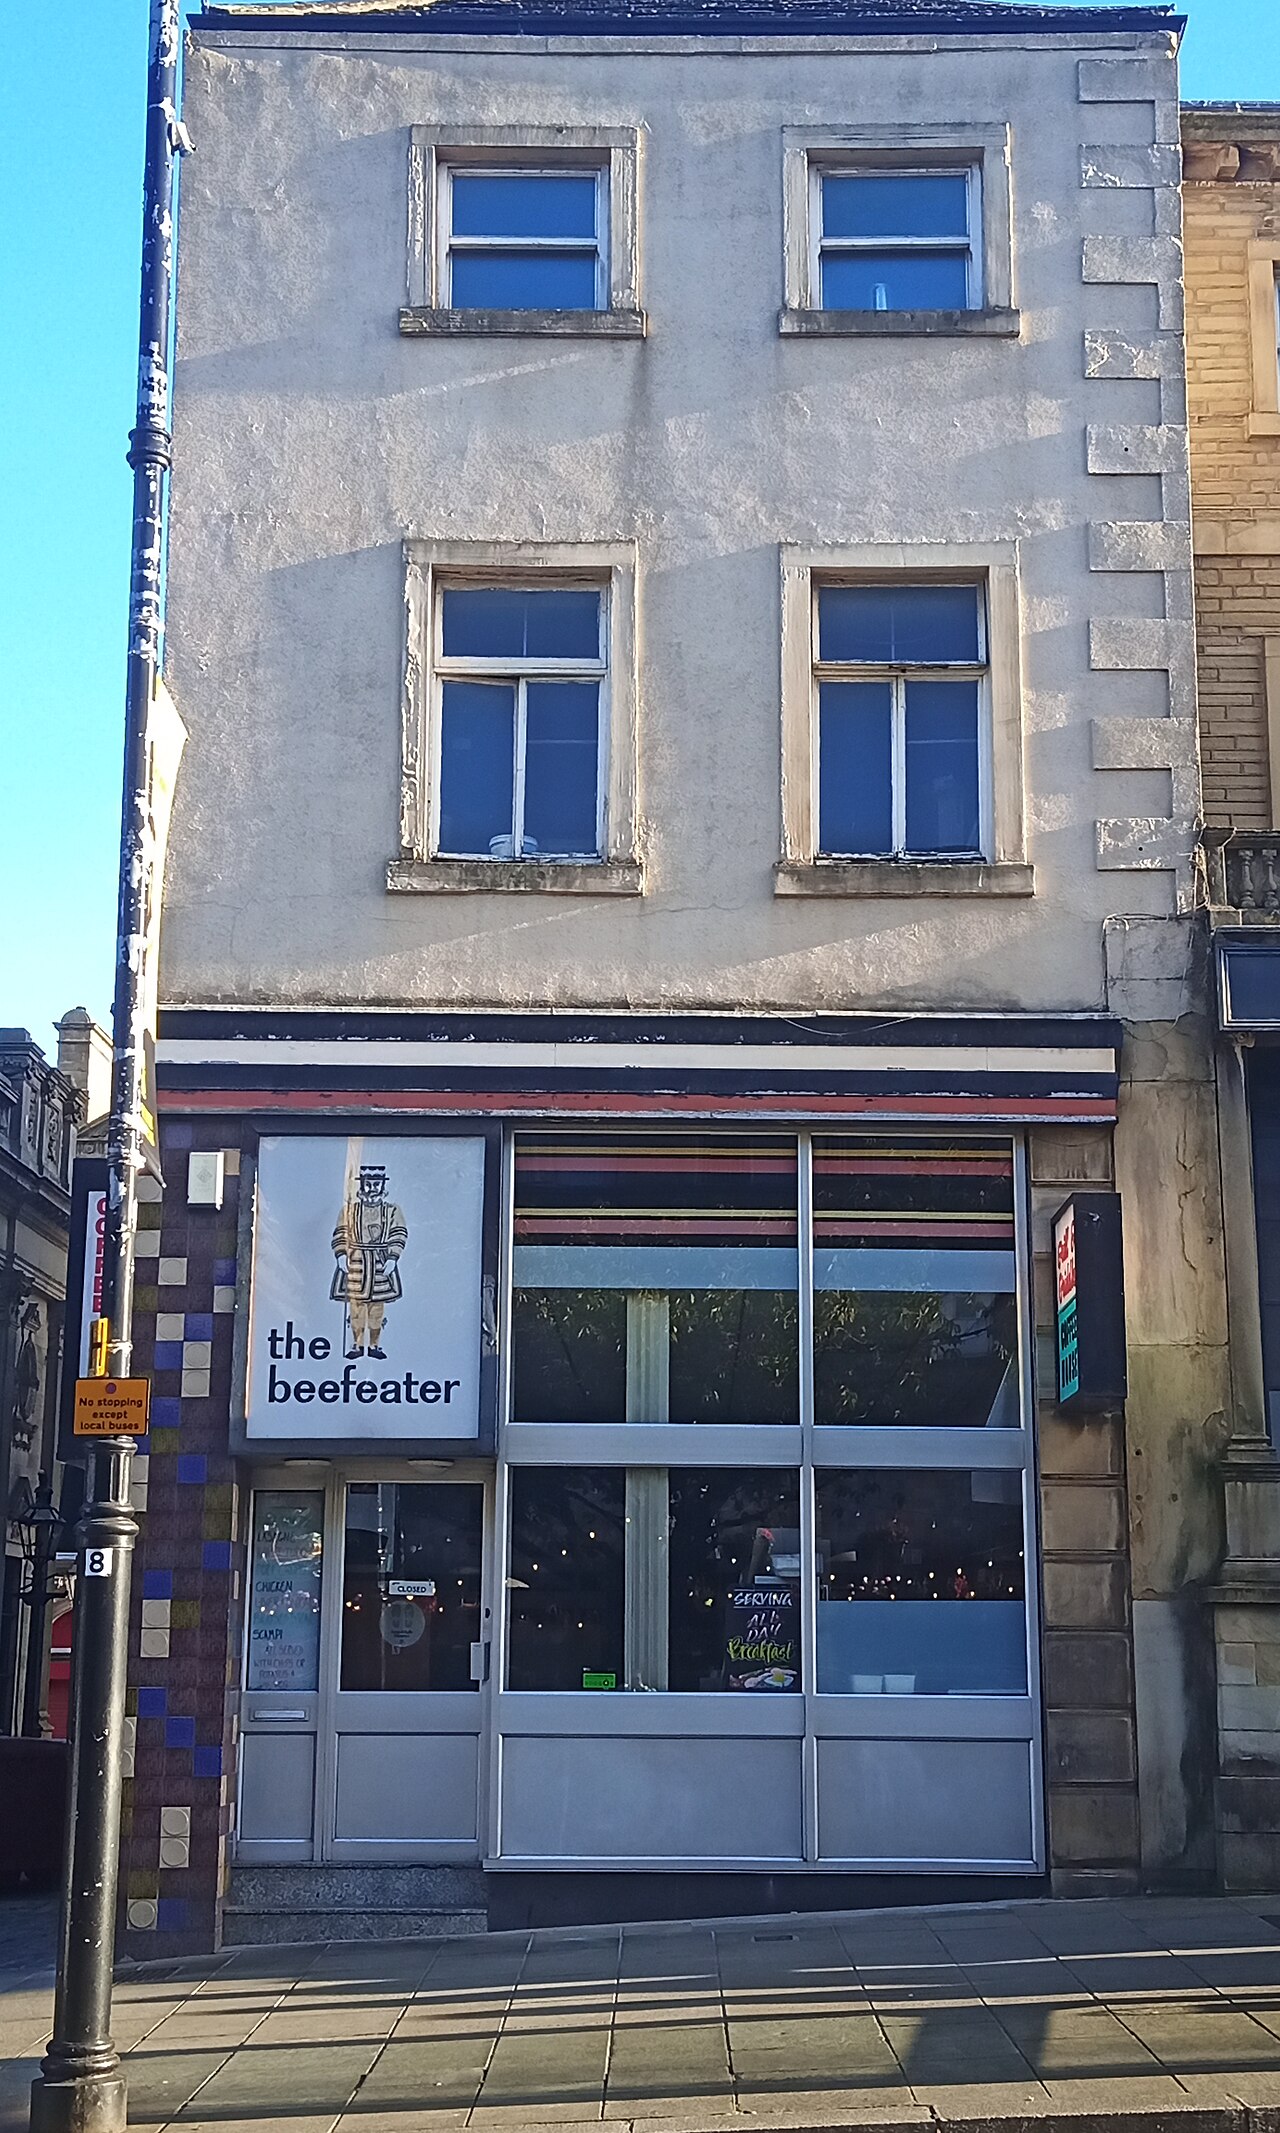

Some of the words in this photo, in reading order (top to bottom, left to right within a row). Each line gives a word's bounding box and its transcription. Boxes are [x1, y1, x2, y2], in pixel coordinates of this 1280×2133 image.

[268, 1321, 331, 1360] the
[268, 1364, 461, 1404] beefeater
[79, 1397, 95, 1407] No
[98, 1397, 143, 1408] stopping
[92, 1411, 128, 1421] except
[80, 1421, 106, 1430] local
[109, 1421, 139, 1430] buses
[89, 1551, 105, 1574] 8
[397, 1585, 427, 1594] CLOSED
[733, 1591, 793, 1607] SERVING
[252, 1628, 283, 1640] SCAMPI
[727, 1636, 793, 1663] Breakfast
